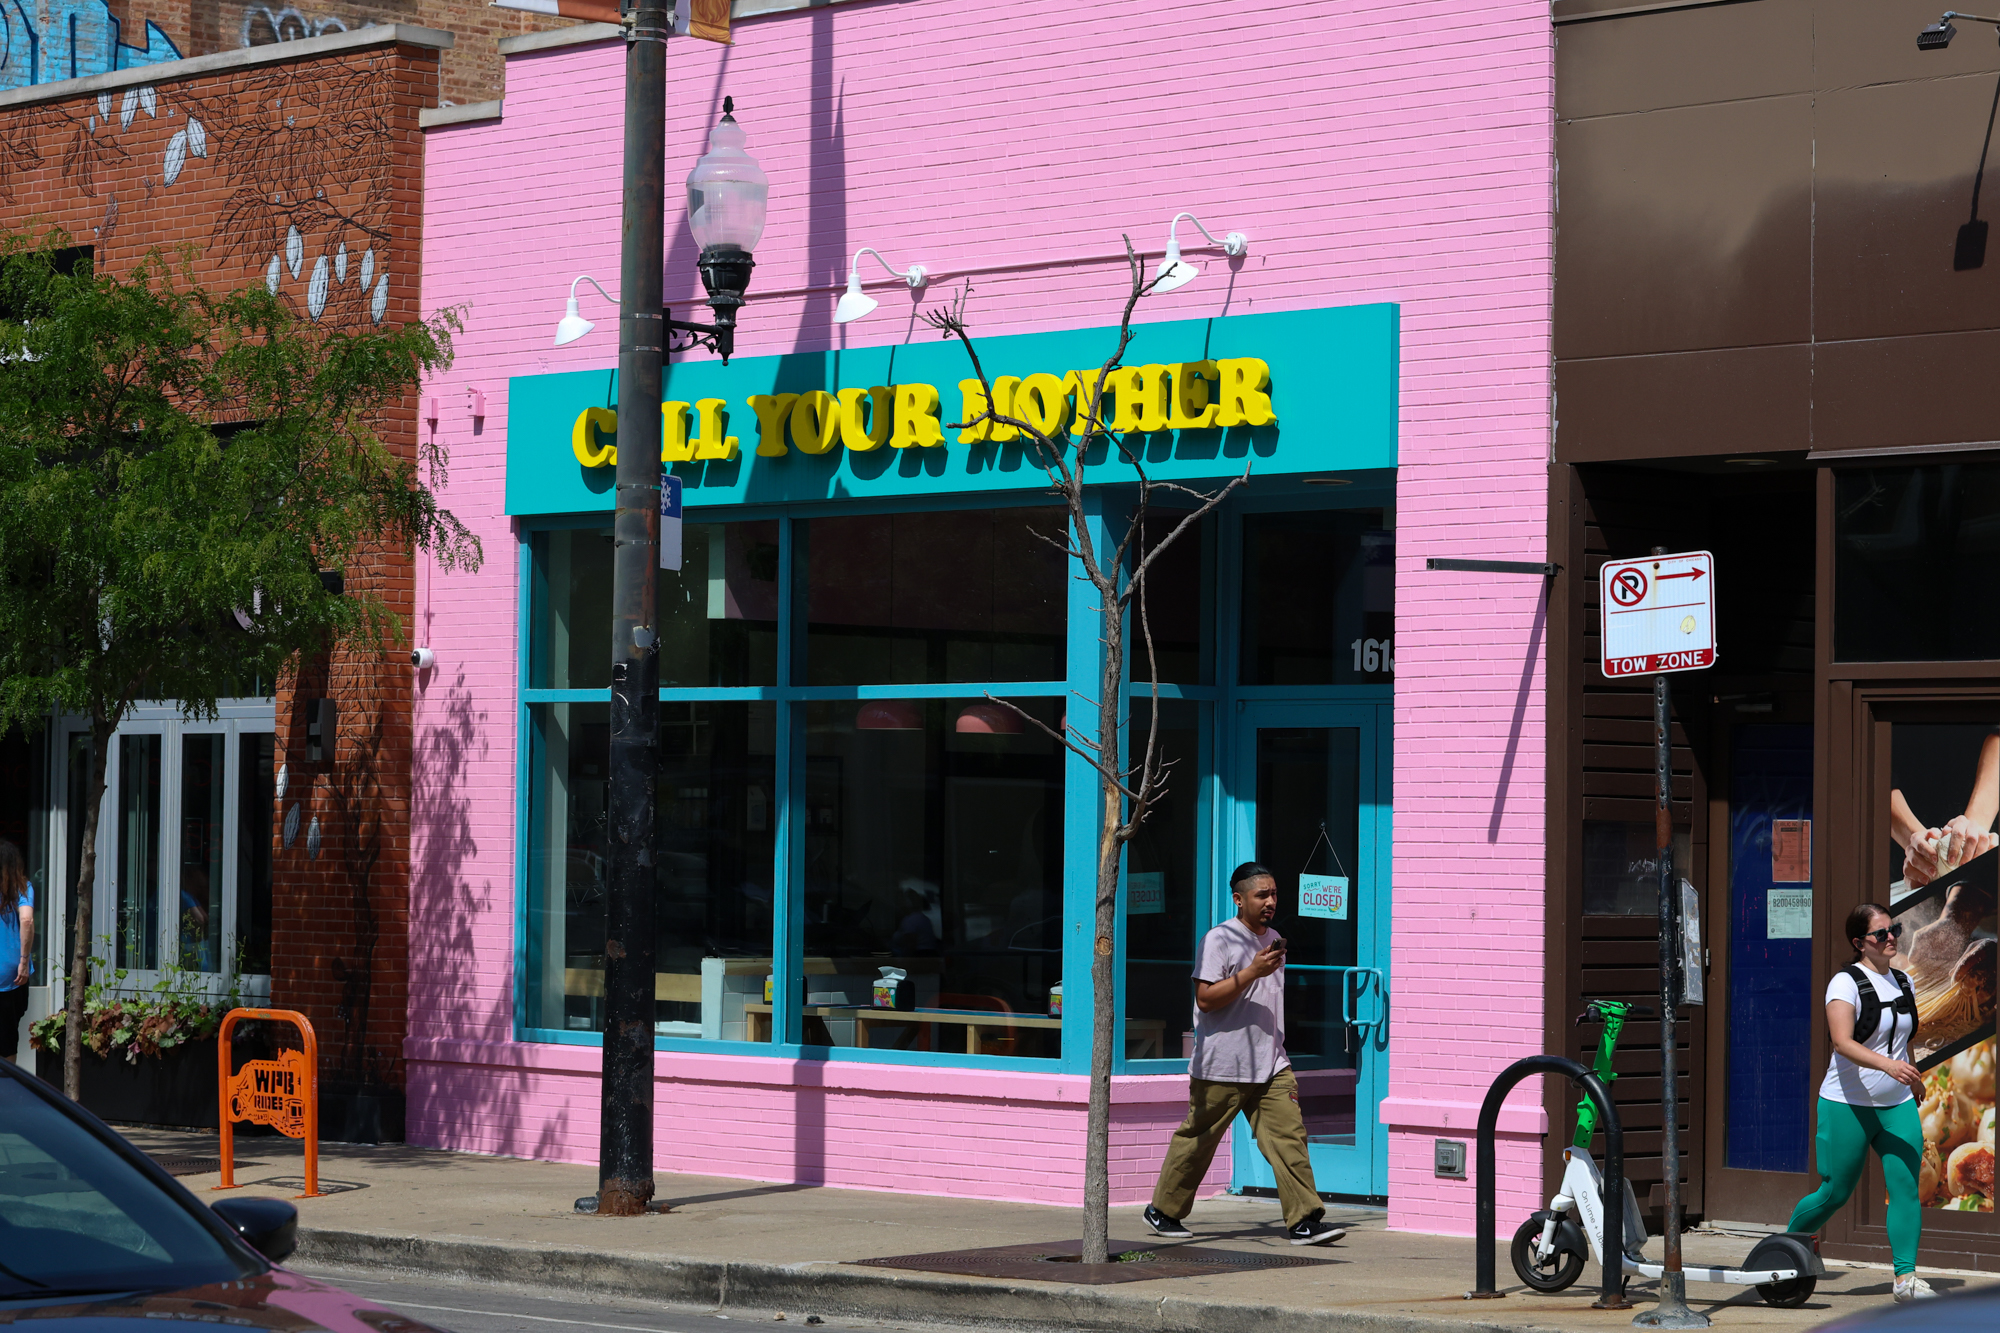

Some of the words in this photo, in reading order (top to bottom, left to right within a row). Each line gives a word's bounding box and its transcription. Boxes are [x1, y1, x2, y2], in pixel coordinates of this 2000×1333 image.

[572, 398, 739, 468] CLL
[747, 383, 946, 457] YOUR
[957, 357, 1277, 443] MOTHER
[1611, 657, 1648, 674] TOW
[1657, 651, 1704, 669] ZONE
[1303, 881, 1321, 890] SORRY
[1322, 885, 1342, 894] WE'RE
[1303, 892, 1342, 907] CLOSED
[254, 1069, 294, 1095] WPB
[254, 1095, 283, 1110] RIDES
[1581, 1190, 1588, 1203] On
[1585, 1203, 1596, 1224] Lime
